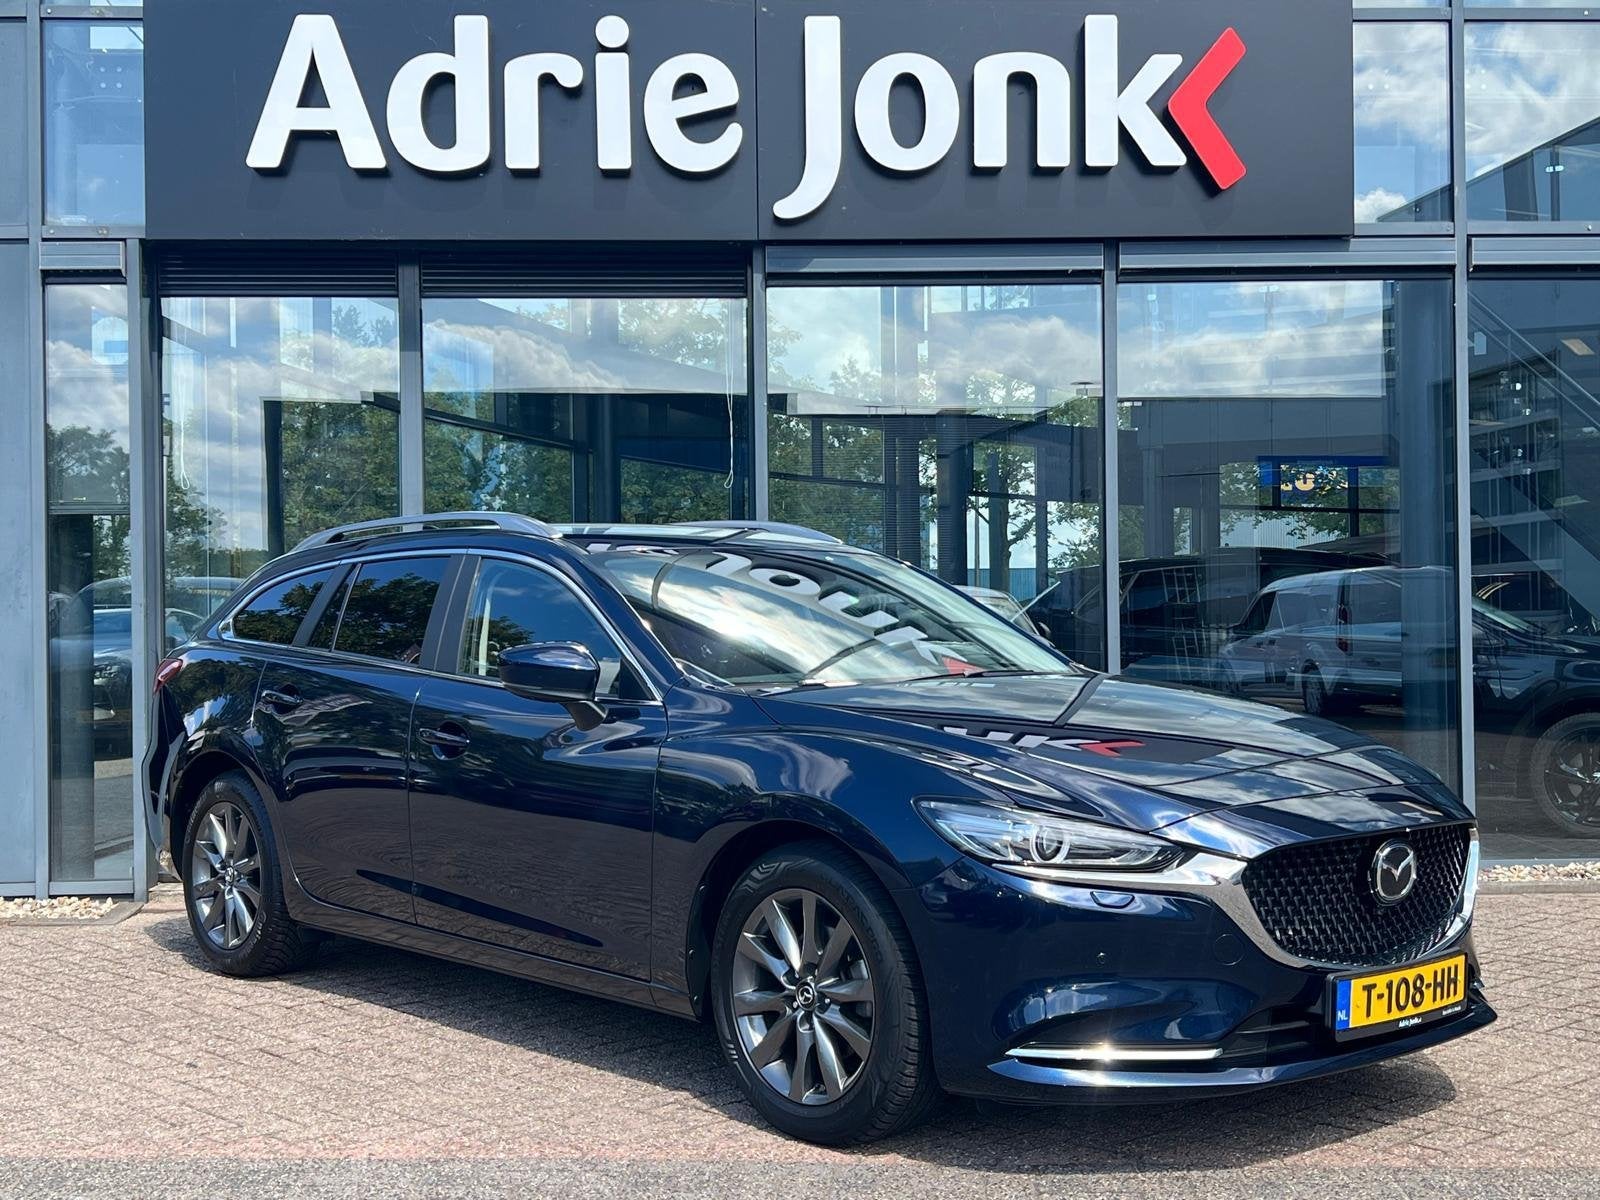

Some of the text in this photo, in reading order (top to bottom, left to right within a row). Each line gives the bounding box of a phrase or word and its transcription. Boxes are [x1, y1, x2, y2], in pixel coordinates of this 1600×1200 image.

[245, 13, 1187, 221] Adrie Jonk
[1337, 964, 1458, 1021] NL T-108-HH
